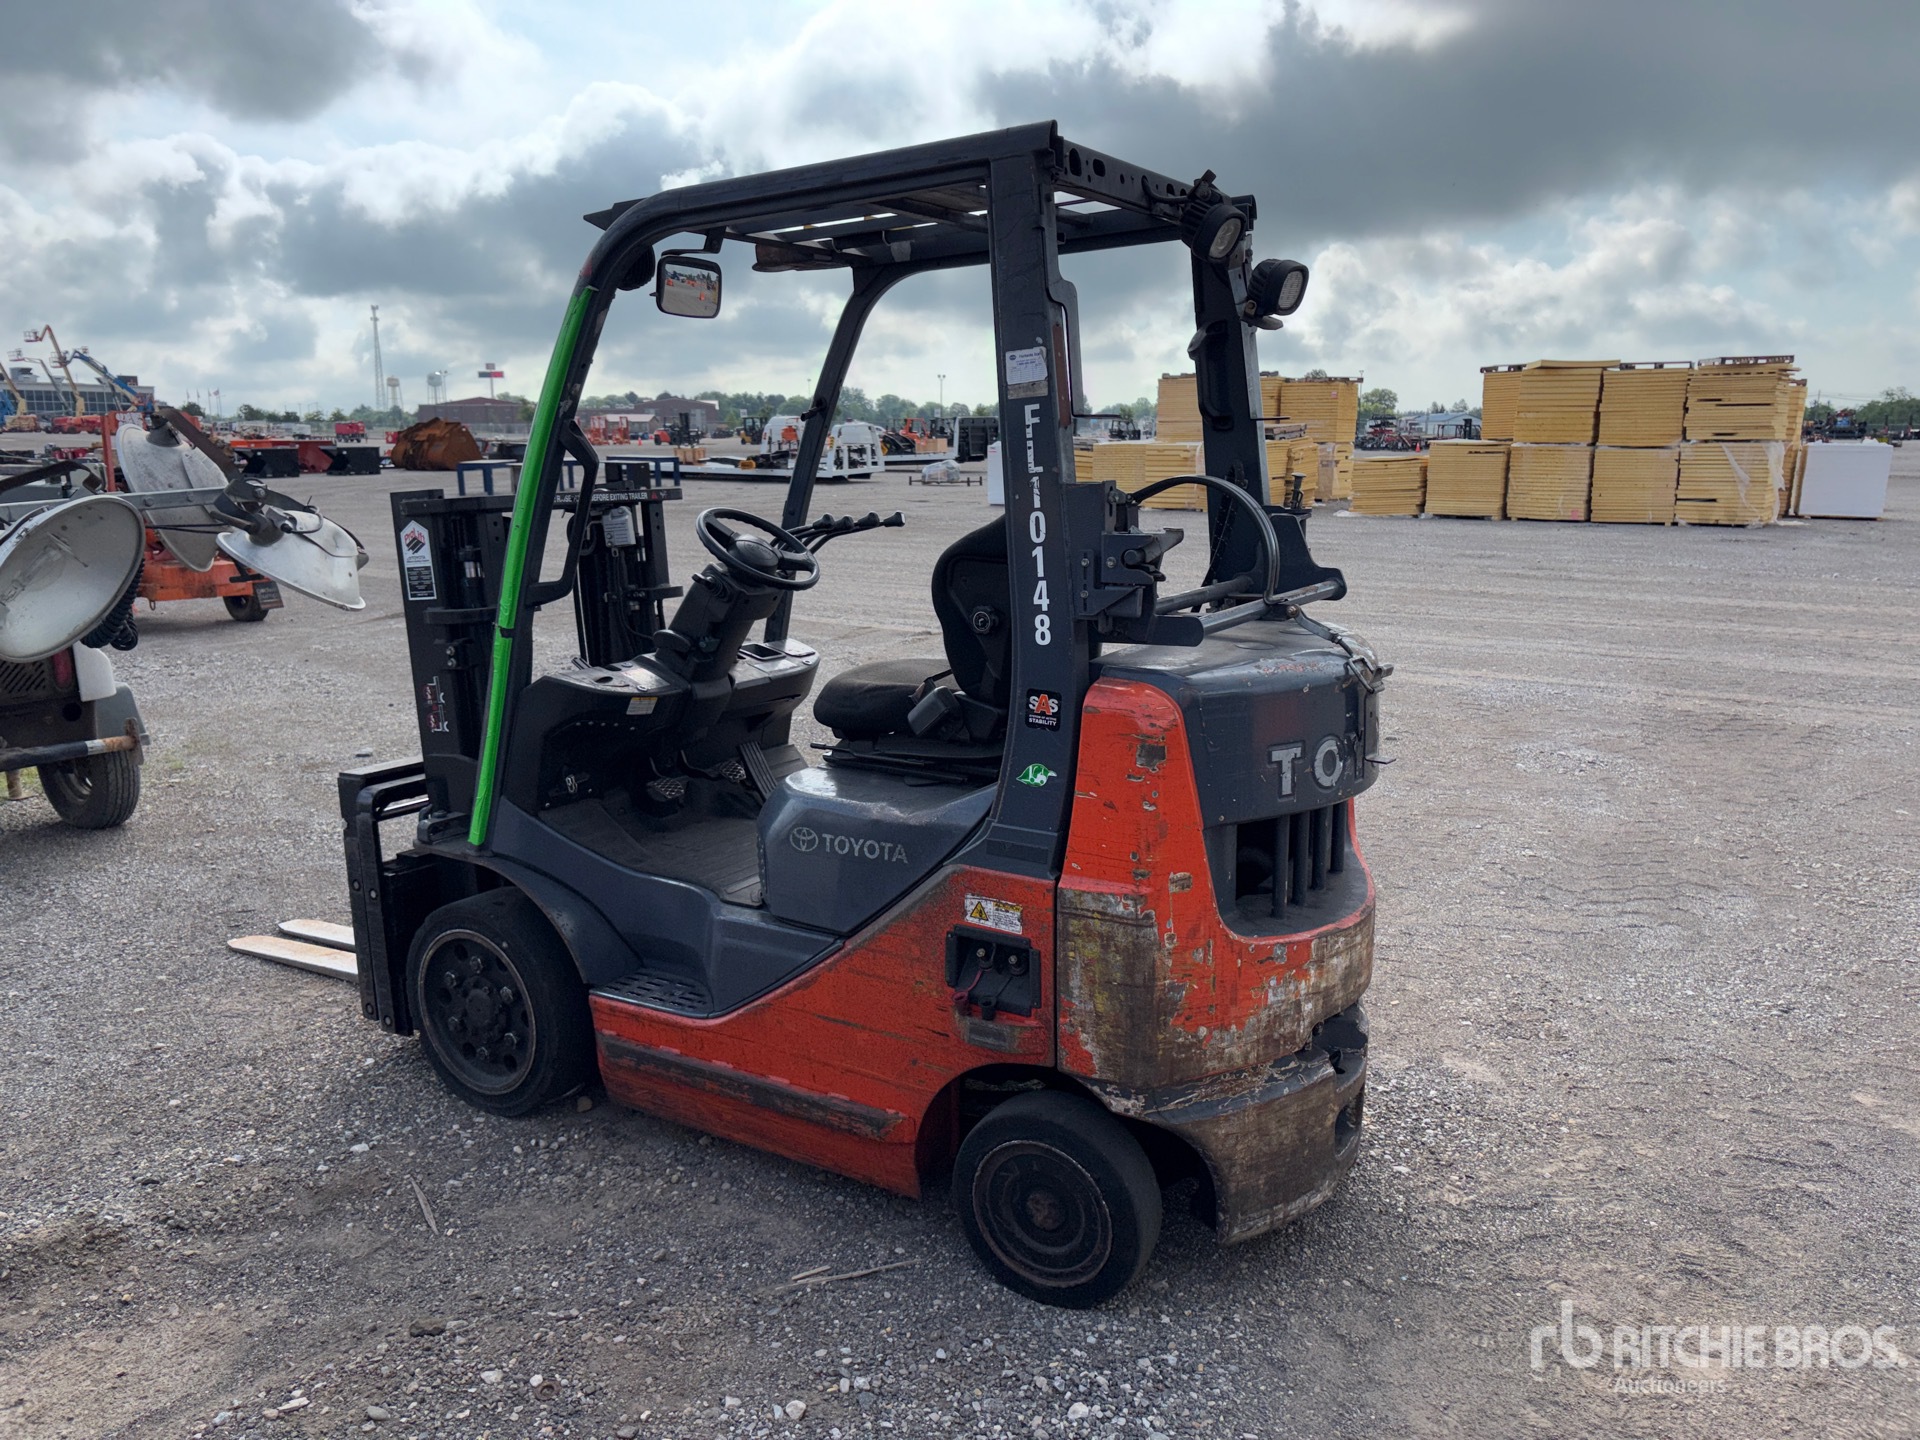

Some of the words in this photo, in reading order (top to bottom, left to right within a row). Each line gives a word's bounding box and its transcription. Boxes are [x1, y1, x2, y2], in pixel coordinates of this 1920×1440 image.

[610, 492, 628, 501] EXITING
[628, 491, 648, 500] TRAILER
[1028, 693, 1059, 716] SAS
[1028, 717, 1057, 726] STABILITY
[821, 833, 909, 864] TOYOTA
